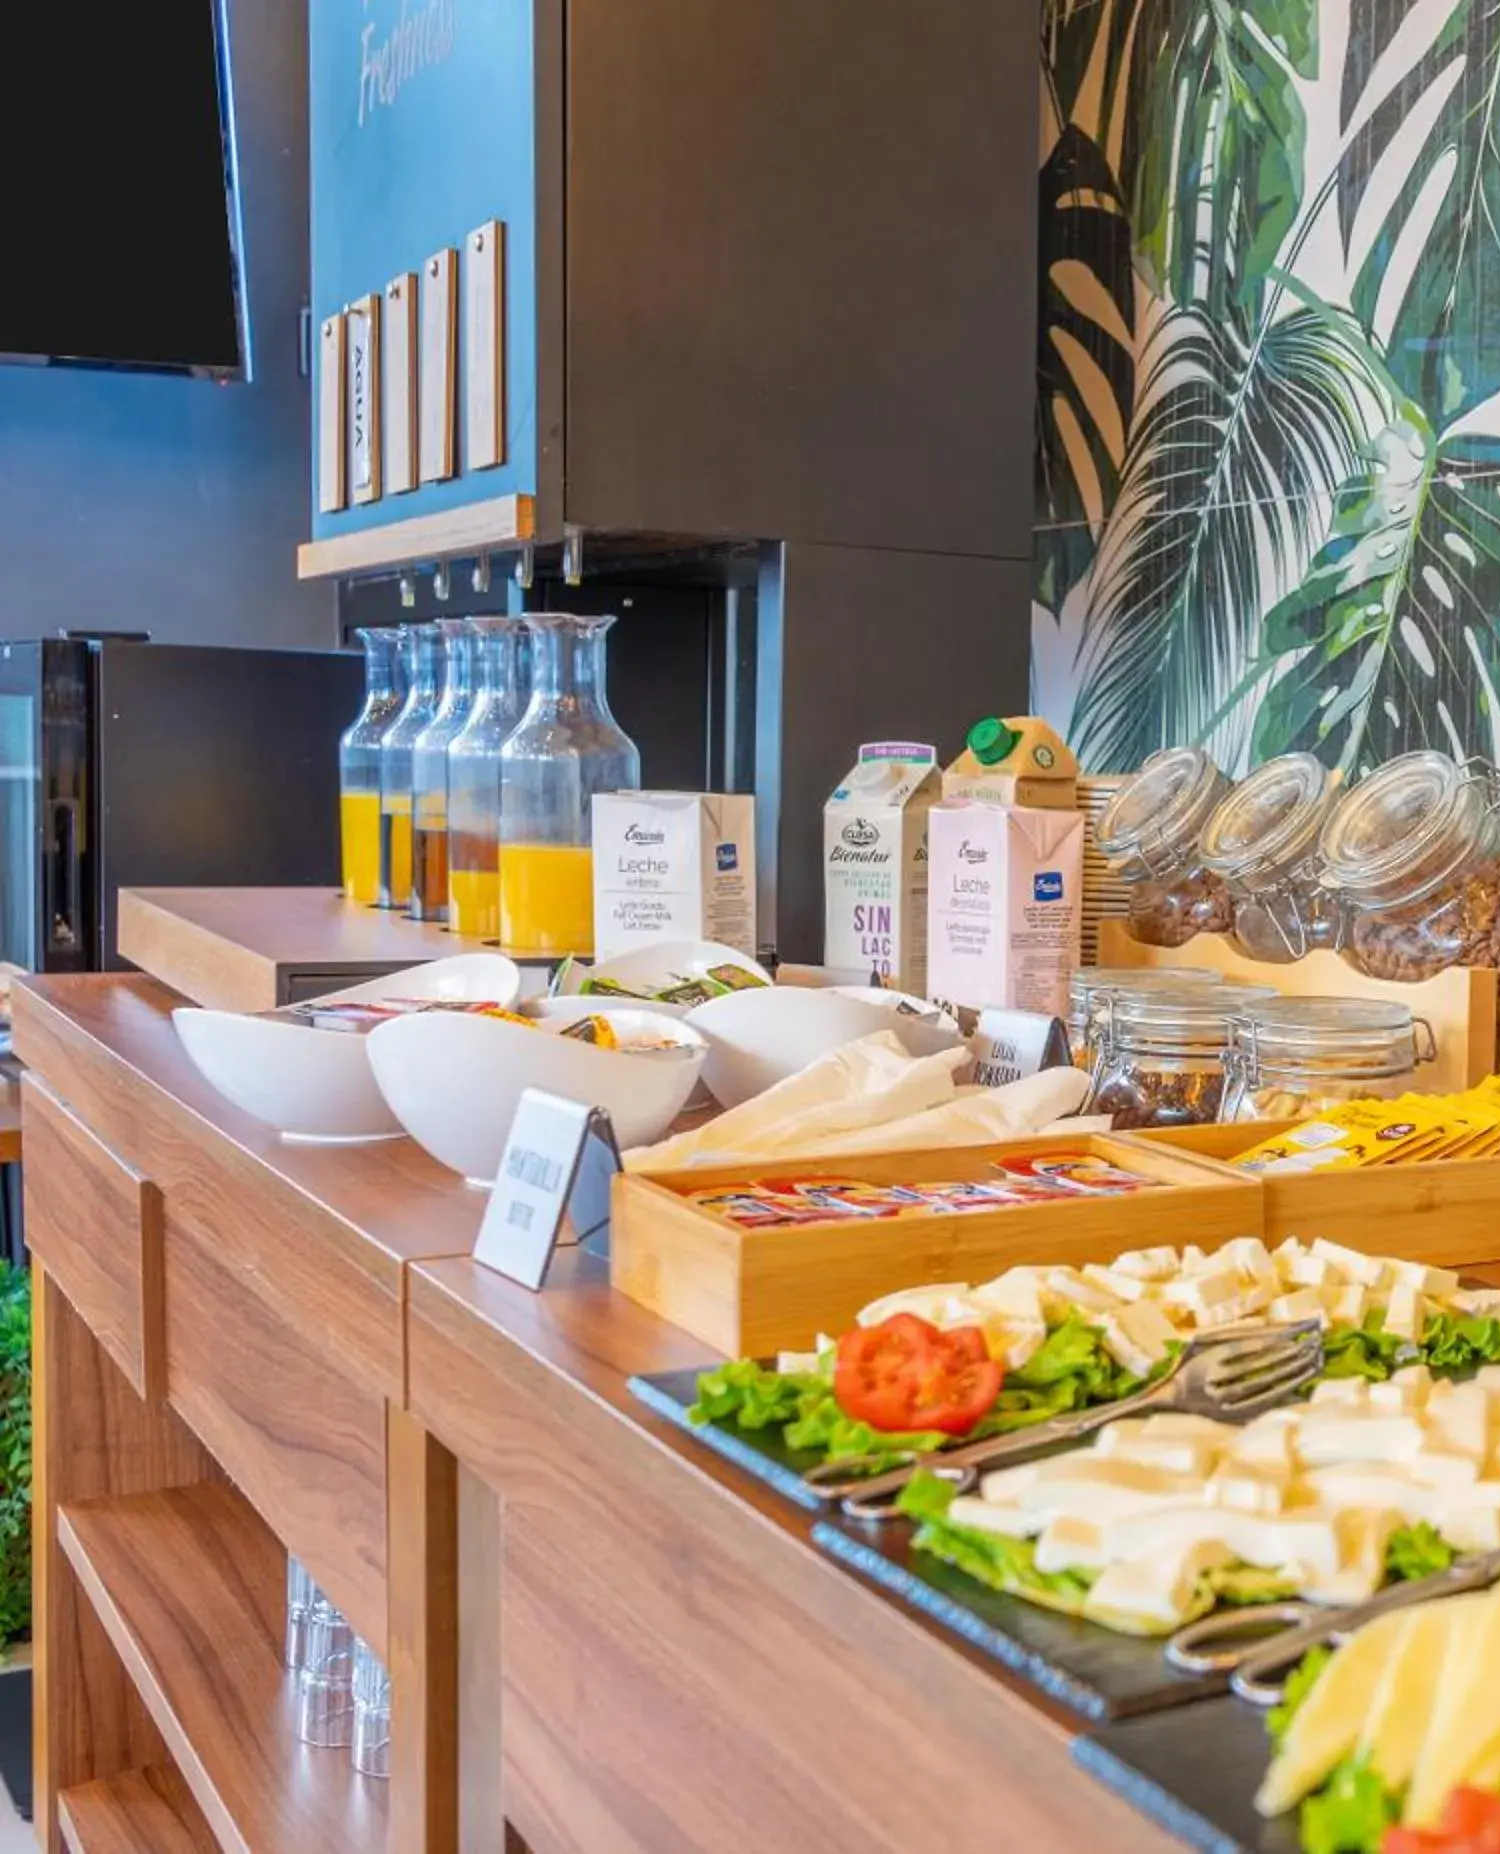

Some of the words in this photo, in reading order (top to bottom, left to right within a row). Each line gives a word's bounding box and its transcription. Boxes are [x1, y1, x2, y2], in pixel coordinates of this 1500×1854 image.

[829, 845, 892, 863] Bienatur
[618, 855, 669, 874] Leche
[952, 873, 991, 895] Leche
[854, 905, 891, 933] SIN
[862, 937, 892, 956] LAC
[872, 960, 891, 978] TO
